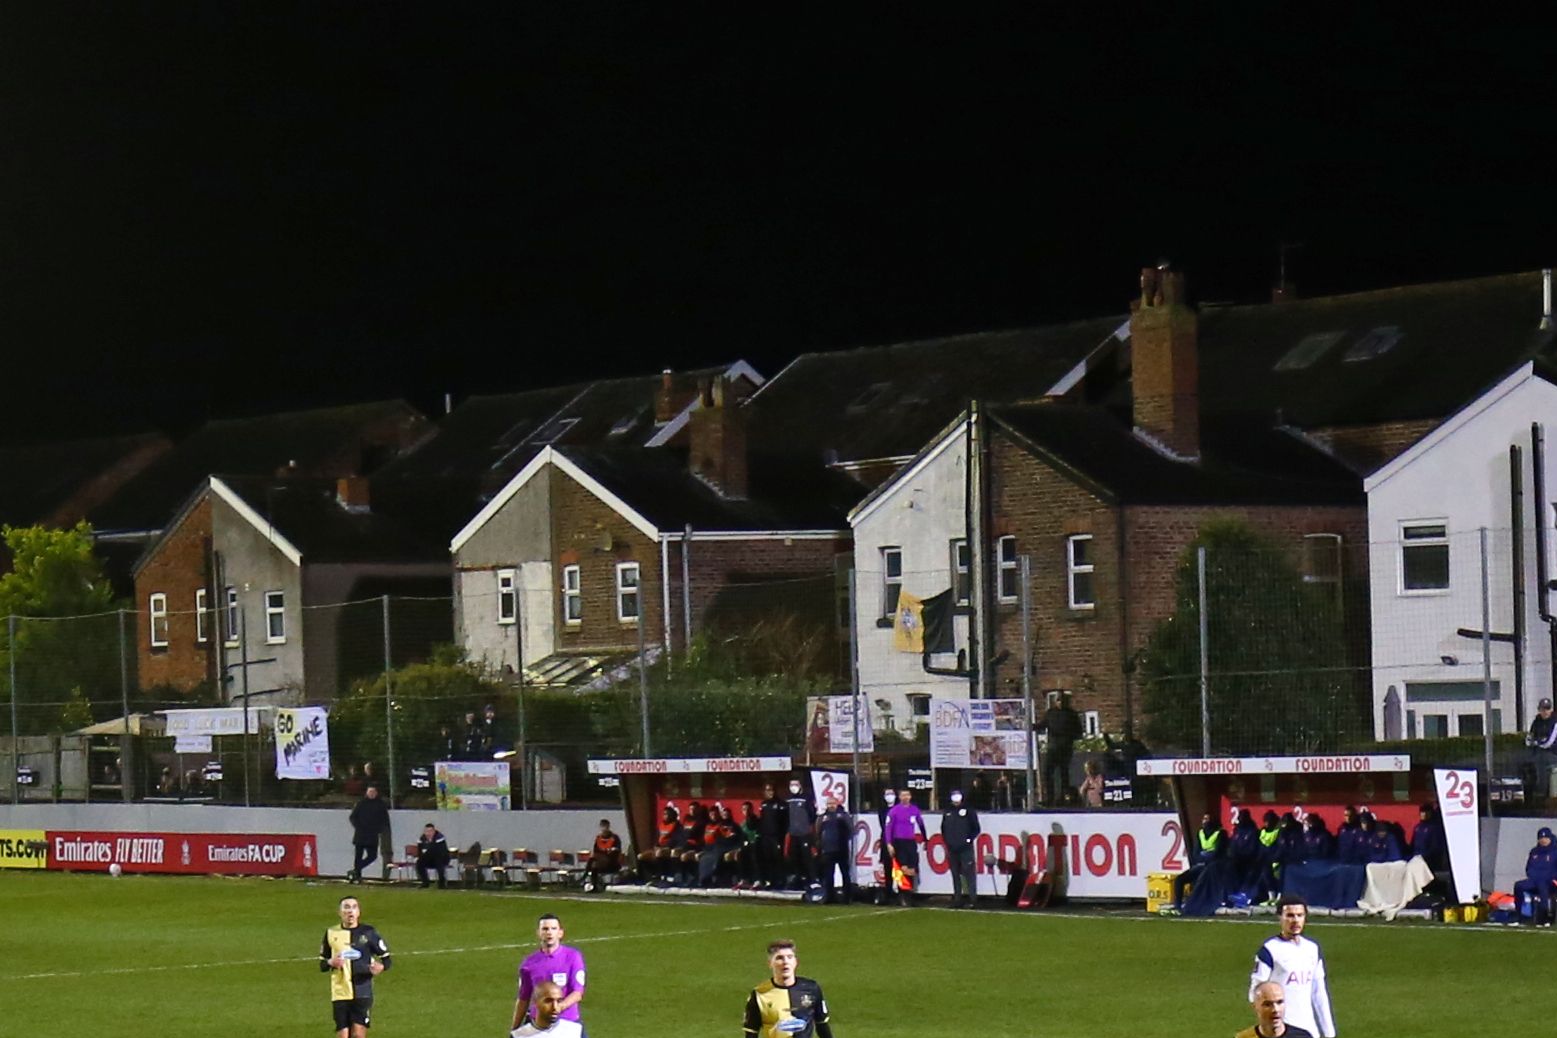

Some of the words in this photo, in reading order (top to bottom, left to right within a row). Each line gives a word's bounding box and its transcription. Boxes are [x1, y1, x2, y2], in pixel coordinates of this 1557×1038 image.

[277, 713, 293, 734] GO
[283, 715, 324, 767] MARINE
[614, 761, 667, 773] FOUNDATION
[706, 759, 761, 771] FOUNDATION
[1172, 760, 1242, 773] FOUNDATION
[1295, 758, 1370, 772] FOUNDATION
[821, 773, 846, 804] 23
[1113, 789, 1123, 801] 21
[1445, 770, 1474, 808] 23
[1502, 789, 1513, 801] 19
[55, 836, 112, 862] Emirates
[115, 838, 131, 863] FLY
[131, 838, 164, 863] BETTER
[208, 844, 247, 862] Emirates
[248, 844, 261, 862] FA
[262, 844, 286, 863] CUP
